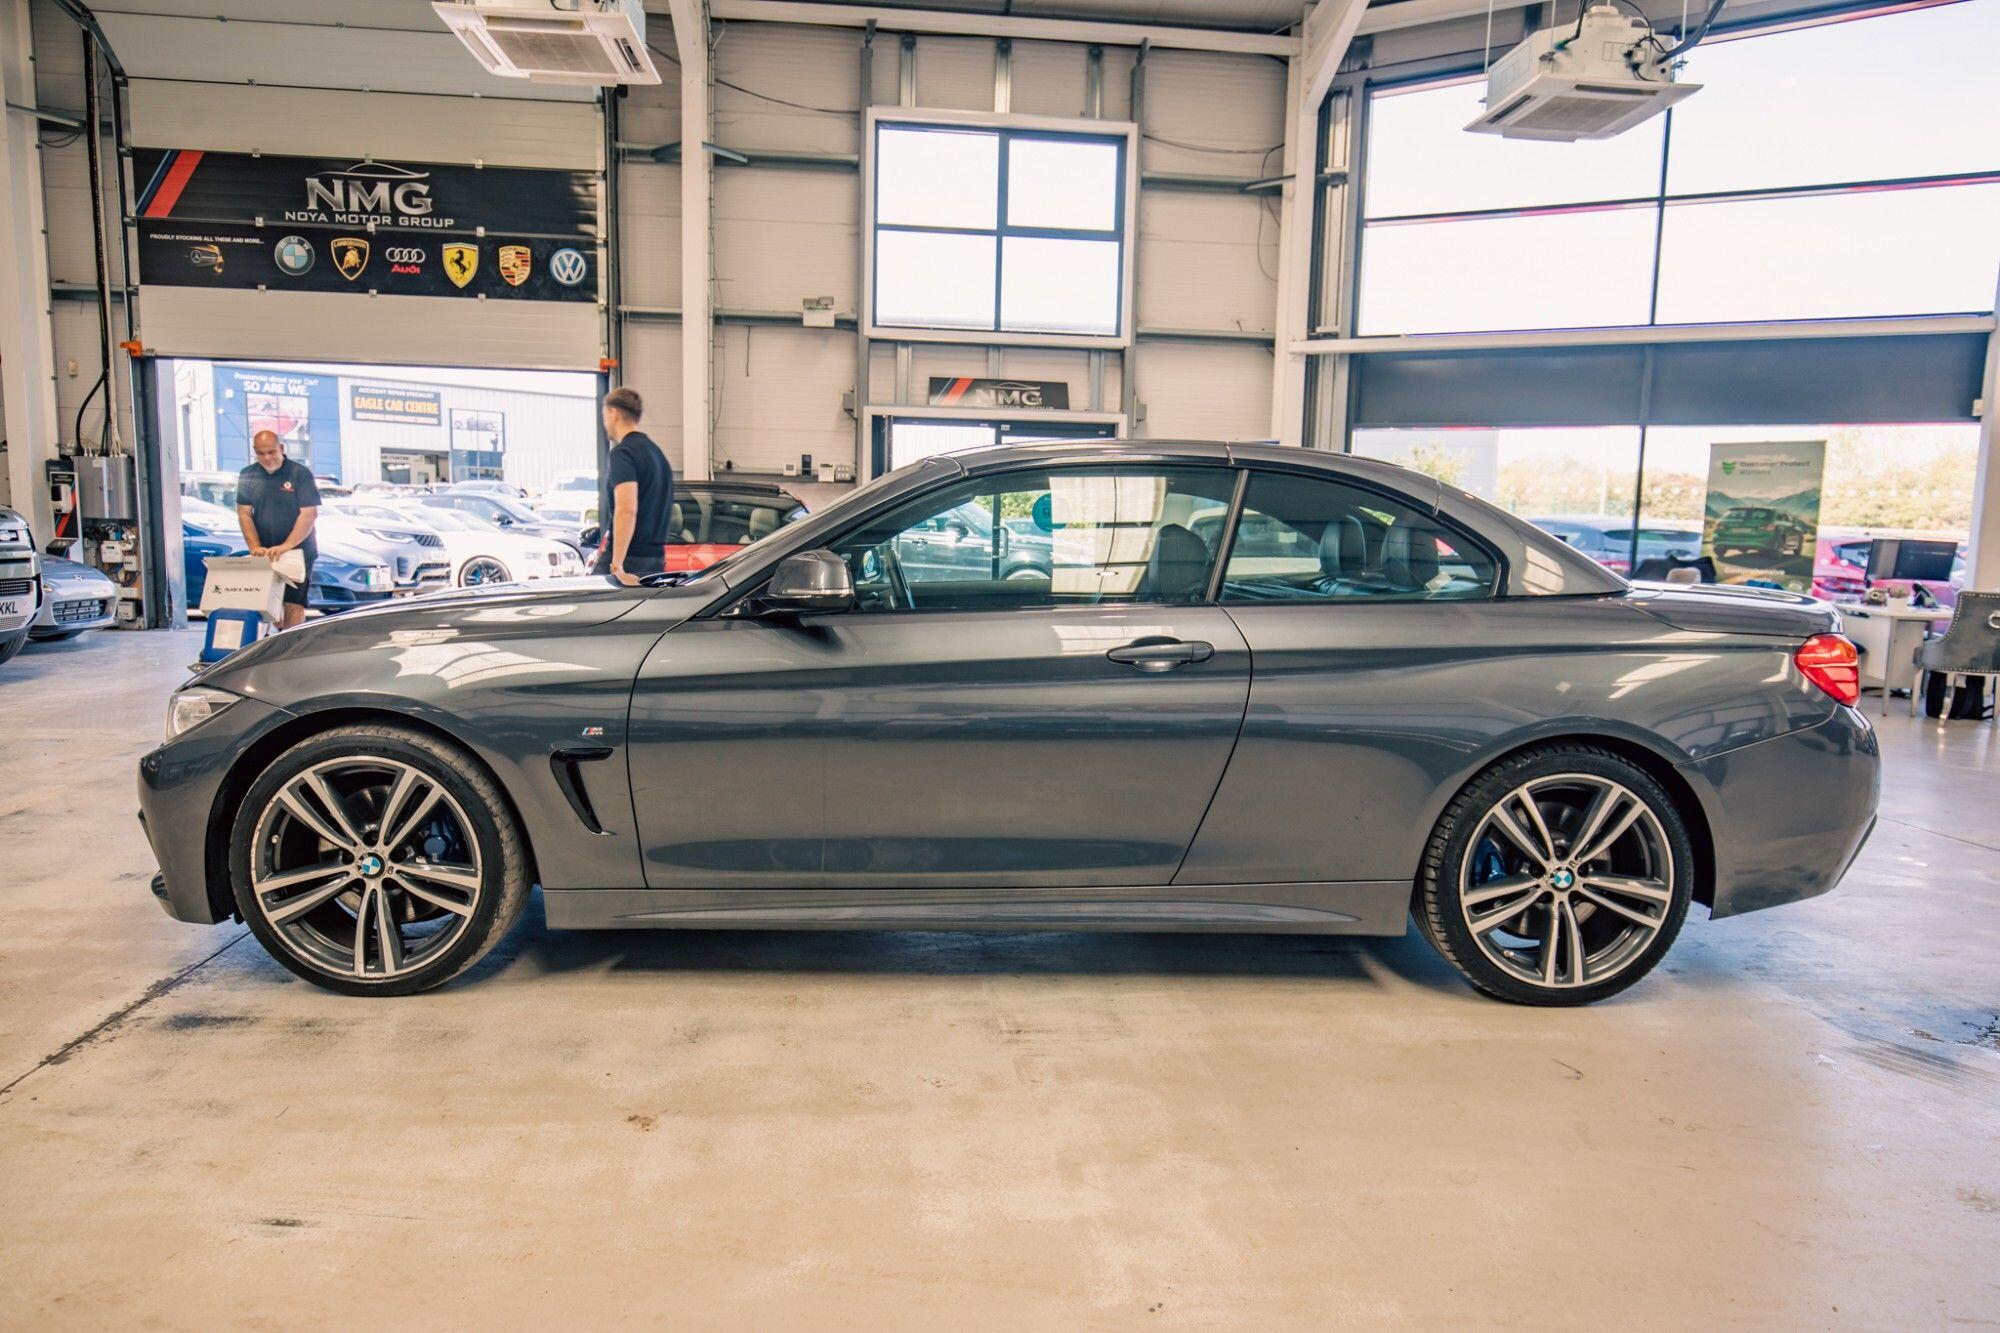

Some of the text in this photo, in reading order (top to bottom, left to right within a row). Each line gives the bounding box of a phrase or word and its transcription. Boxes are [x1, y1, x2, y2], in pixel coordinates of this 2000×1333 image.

[305, 177, 432, 215] NMG
[285, 211, 454, 228] NOYA MOTOR GROUP
[243, 380, 260, 392] SO
[263, 382, 286, 394] ARE
[354, 396, 439, 415] EAGLE CAR CENTRE
[976, 388, 1043, 406] NMG
